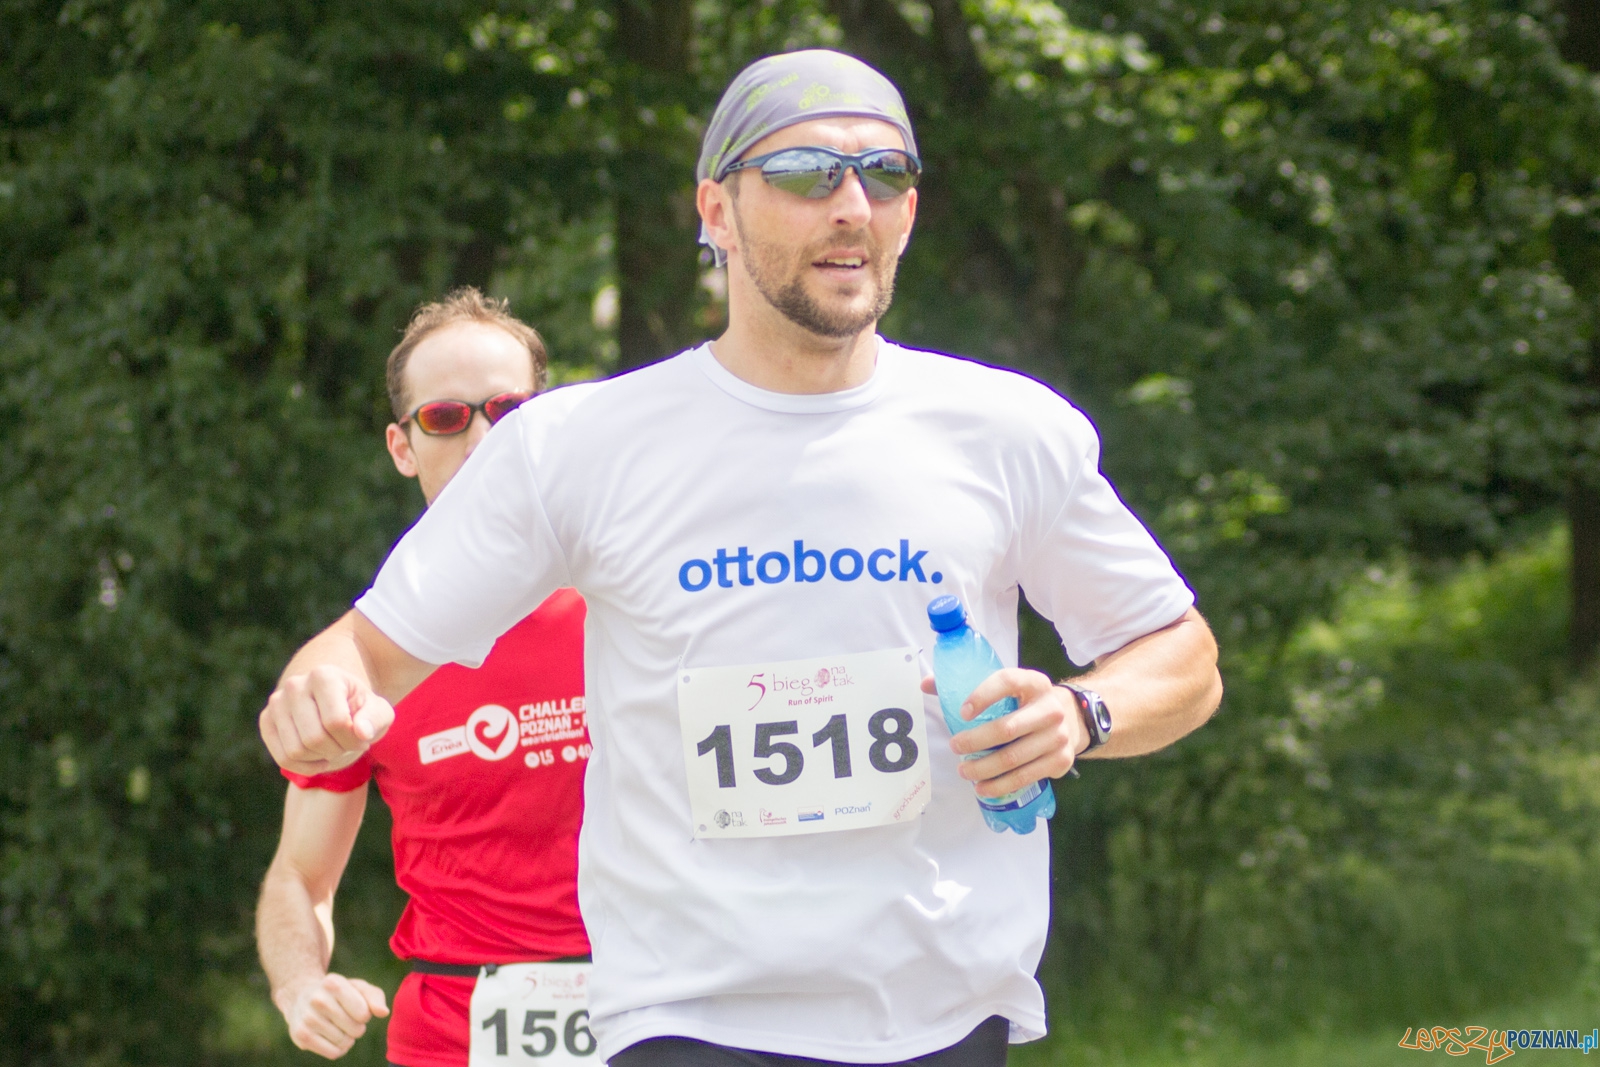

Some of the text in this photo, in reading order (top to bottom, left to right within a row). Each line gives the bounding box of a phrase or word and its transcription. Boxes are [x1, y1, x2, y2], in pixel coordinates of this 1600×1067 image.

[678, 539, 943, 592] ottobock.
[831, 666, 846, 675] na
[833, 674, 855, 687] tak
[747, 673, 813, 711] 5 bieg
[804, 697, 812, 705] of
[814, 695, 834, 705] Spirit
[696, 707, 919, 788] 1518
[482, 1008, 598, 1058] 156
